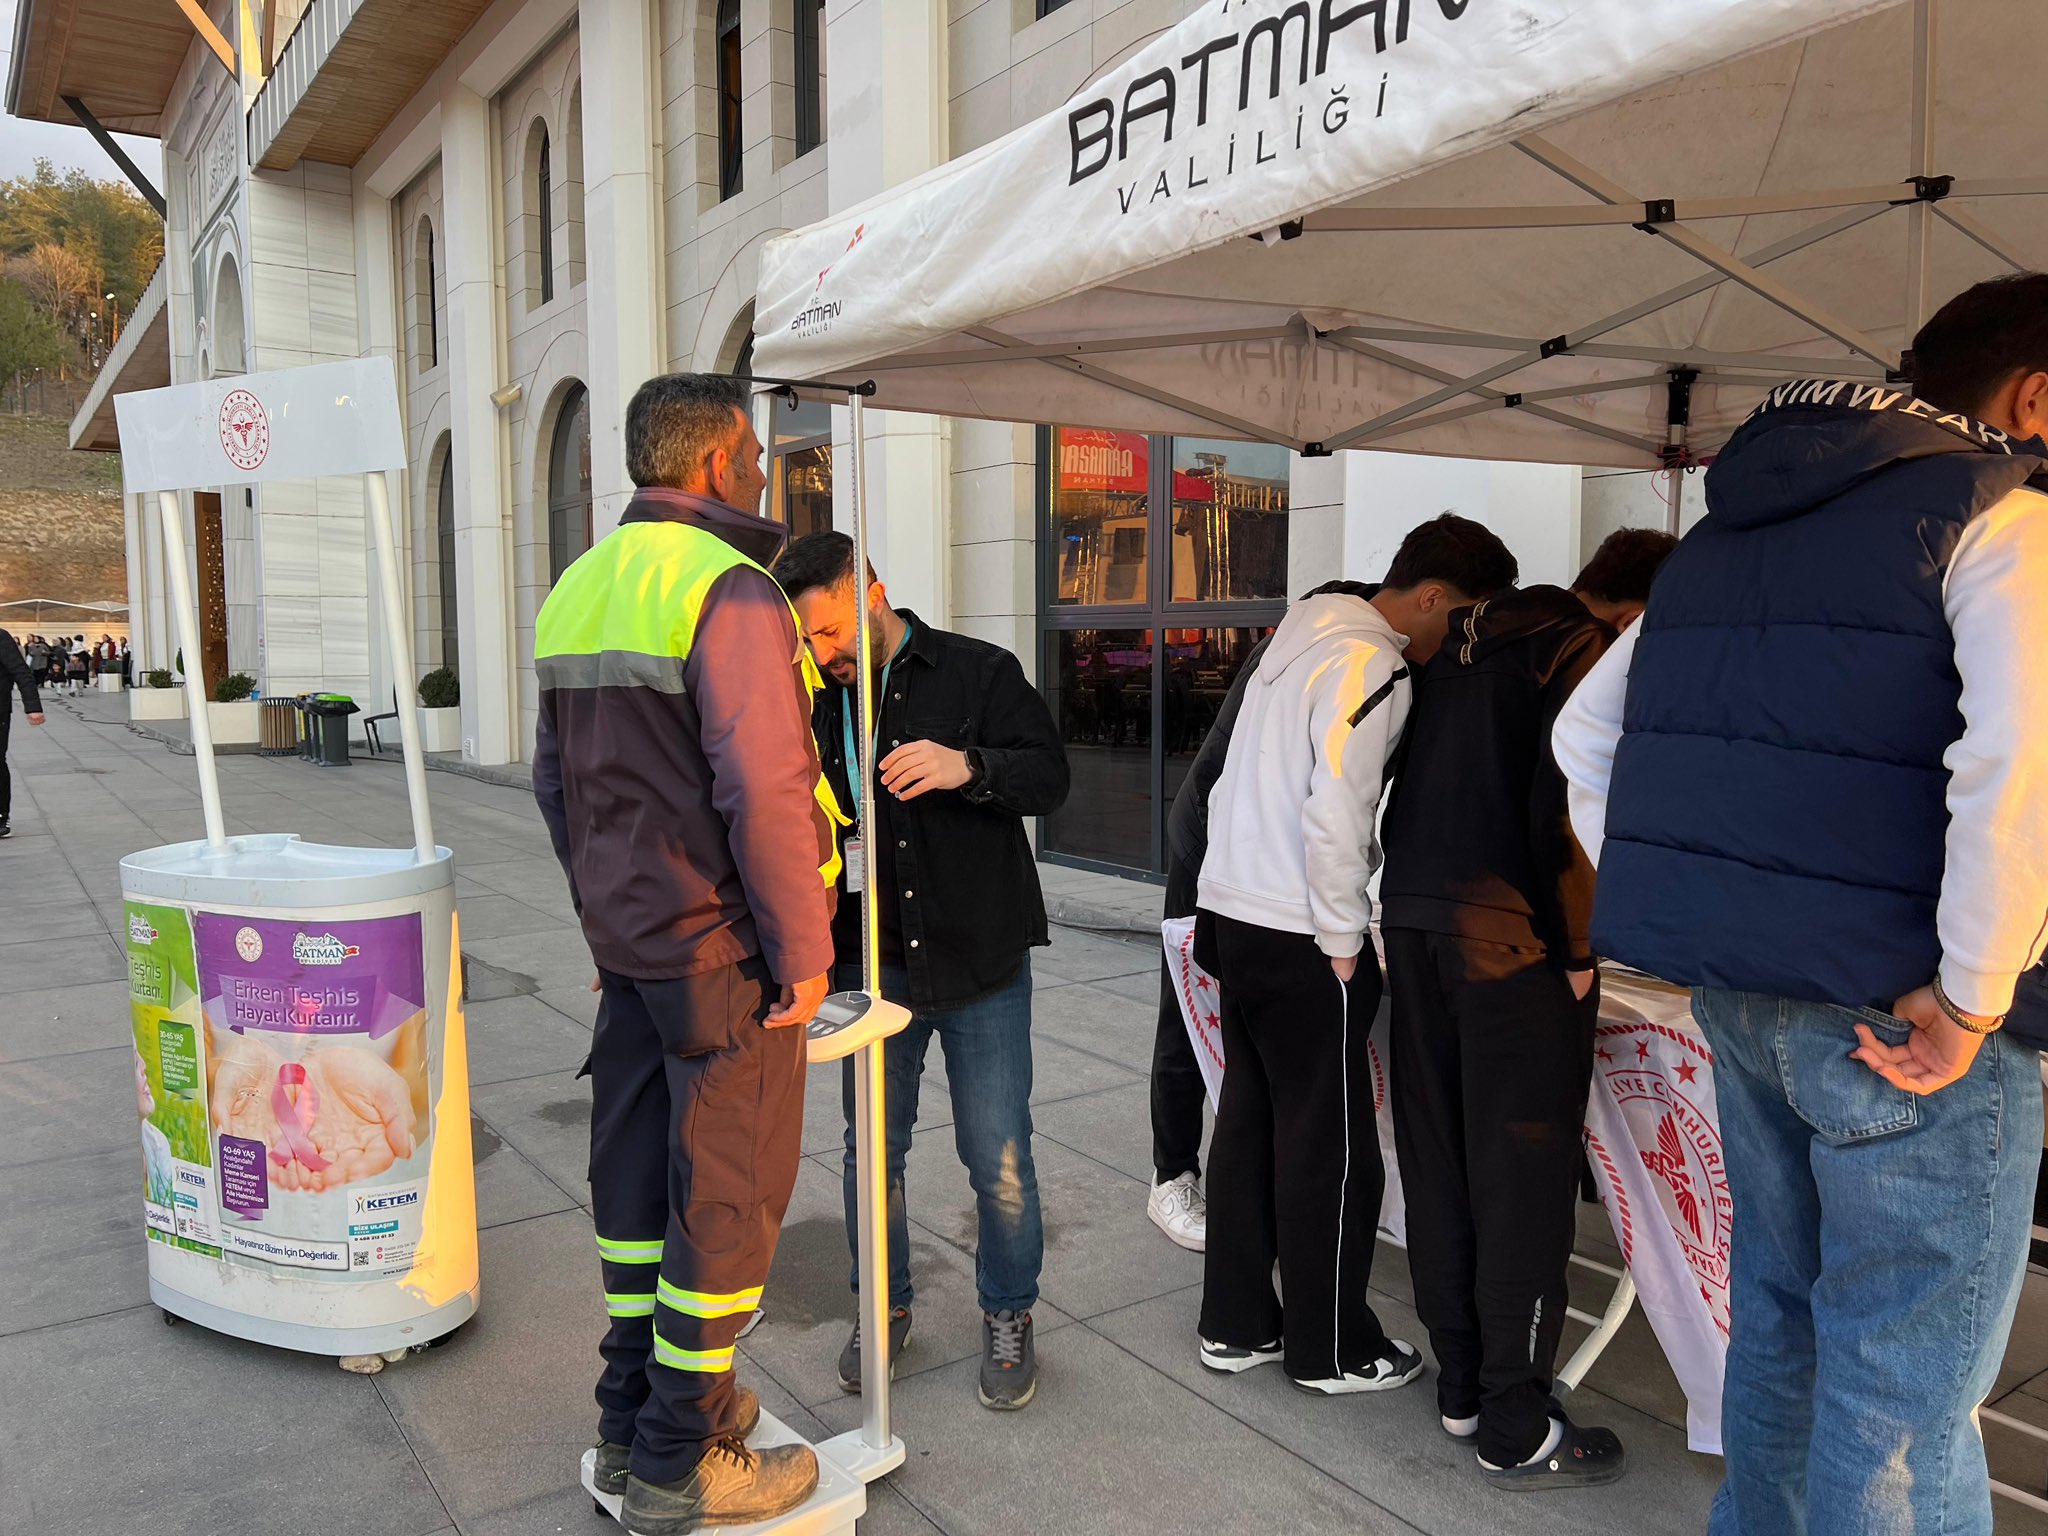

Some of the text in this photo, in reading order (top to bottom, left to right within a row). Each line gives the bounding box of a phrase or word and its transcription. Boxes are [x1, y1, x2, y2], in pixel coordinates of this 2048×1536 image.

[1116, 72, 1389, 215] VALİLİĞİ
[790, 299, 842, 330] BATMAN
[1740, 378, 2013, 456] NIMWEAR
[294, 946, 346, 959] BATMAN
[234, 979, 359, 1009] Erken Teşhis
[235, 1002, 360, 1026] Hayat Kurtarır.
[223, 1145, 256, 1160] 40-69 YAŞ
[180, 1171, 206, 1187] KETEM
[367, 1192, 418, 1209] KETEM
[370, 1222, 395, 1230] ULAŞIN
[264, 1243, 284, 1256] Bizim
[284, 1245, 298, 1258] İçin
[299, 1249, 340, 1261] Değerlidir.
